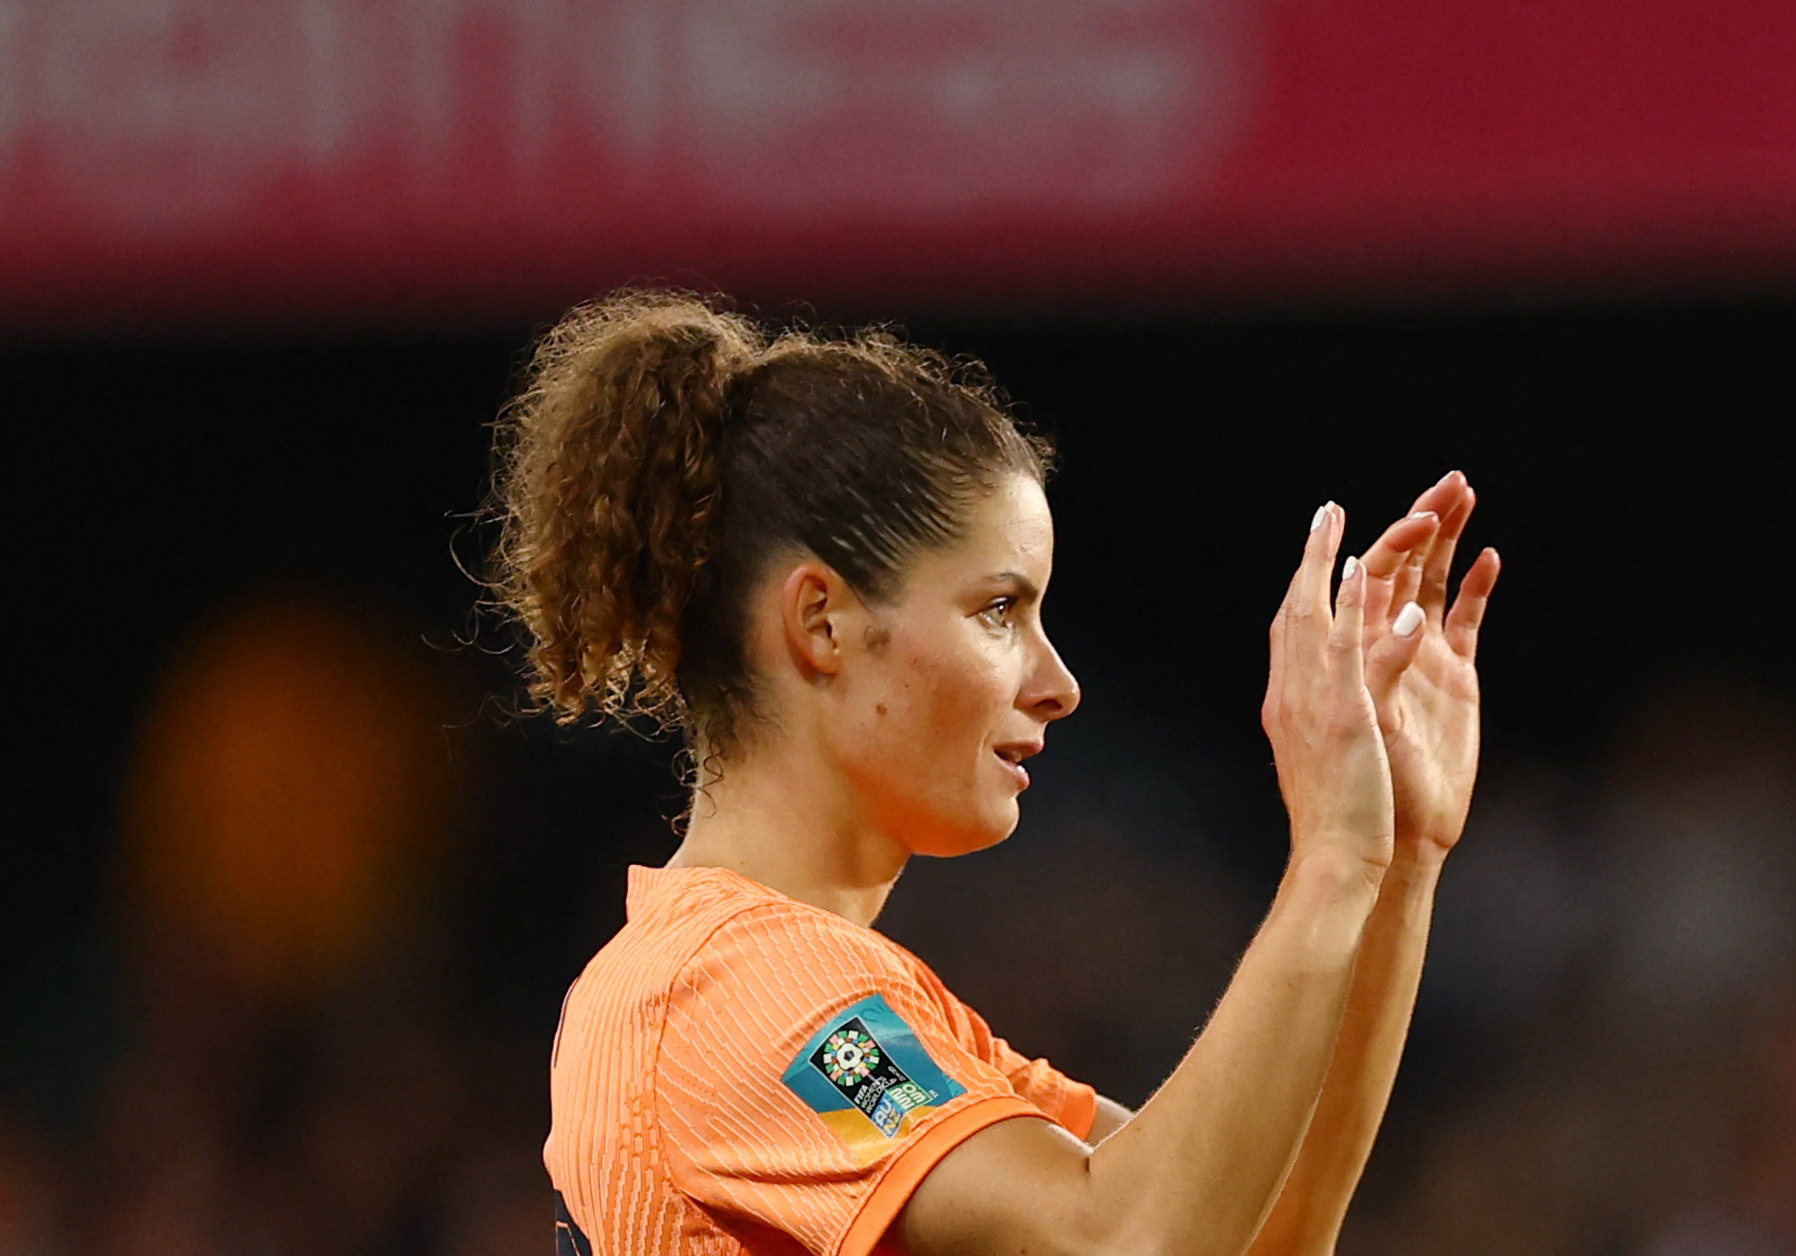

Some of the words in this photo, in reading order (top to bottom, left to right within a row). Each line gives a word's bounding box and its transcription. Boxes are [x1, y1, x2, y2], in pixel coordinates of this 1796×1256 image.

[854, 1084, 868, 1104] FIFA
[865, 1085, 883, 1113] WORLD
[882, 1077, 897, 1090] CUP
[875, 1099, 892, 1126] AU
[883, 1108, 900, 1135] NZ
